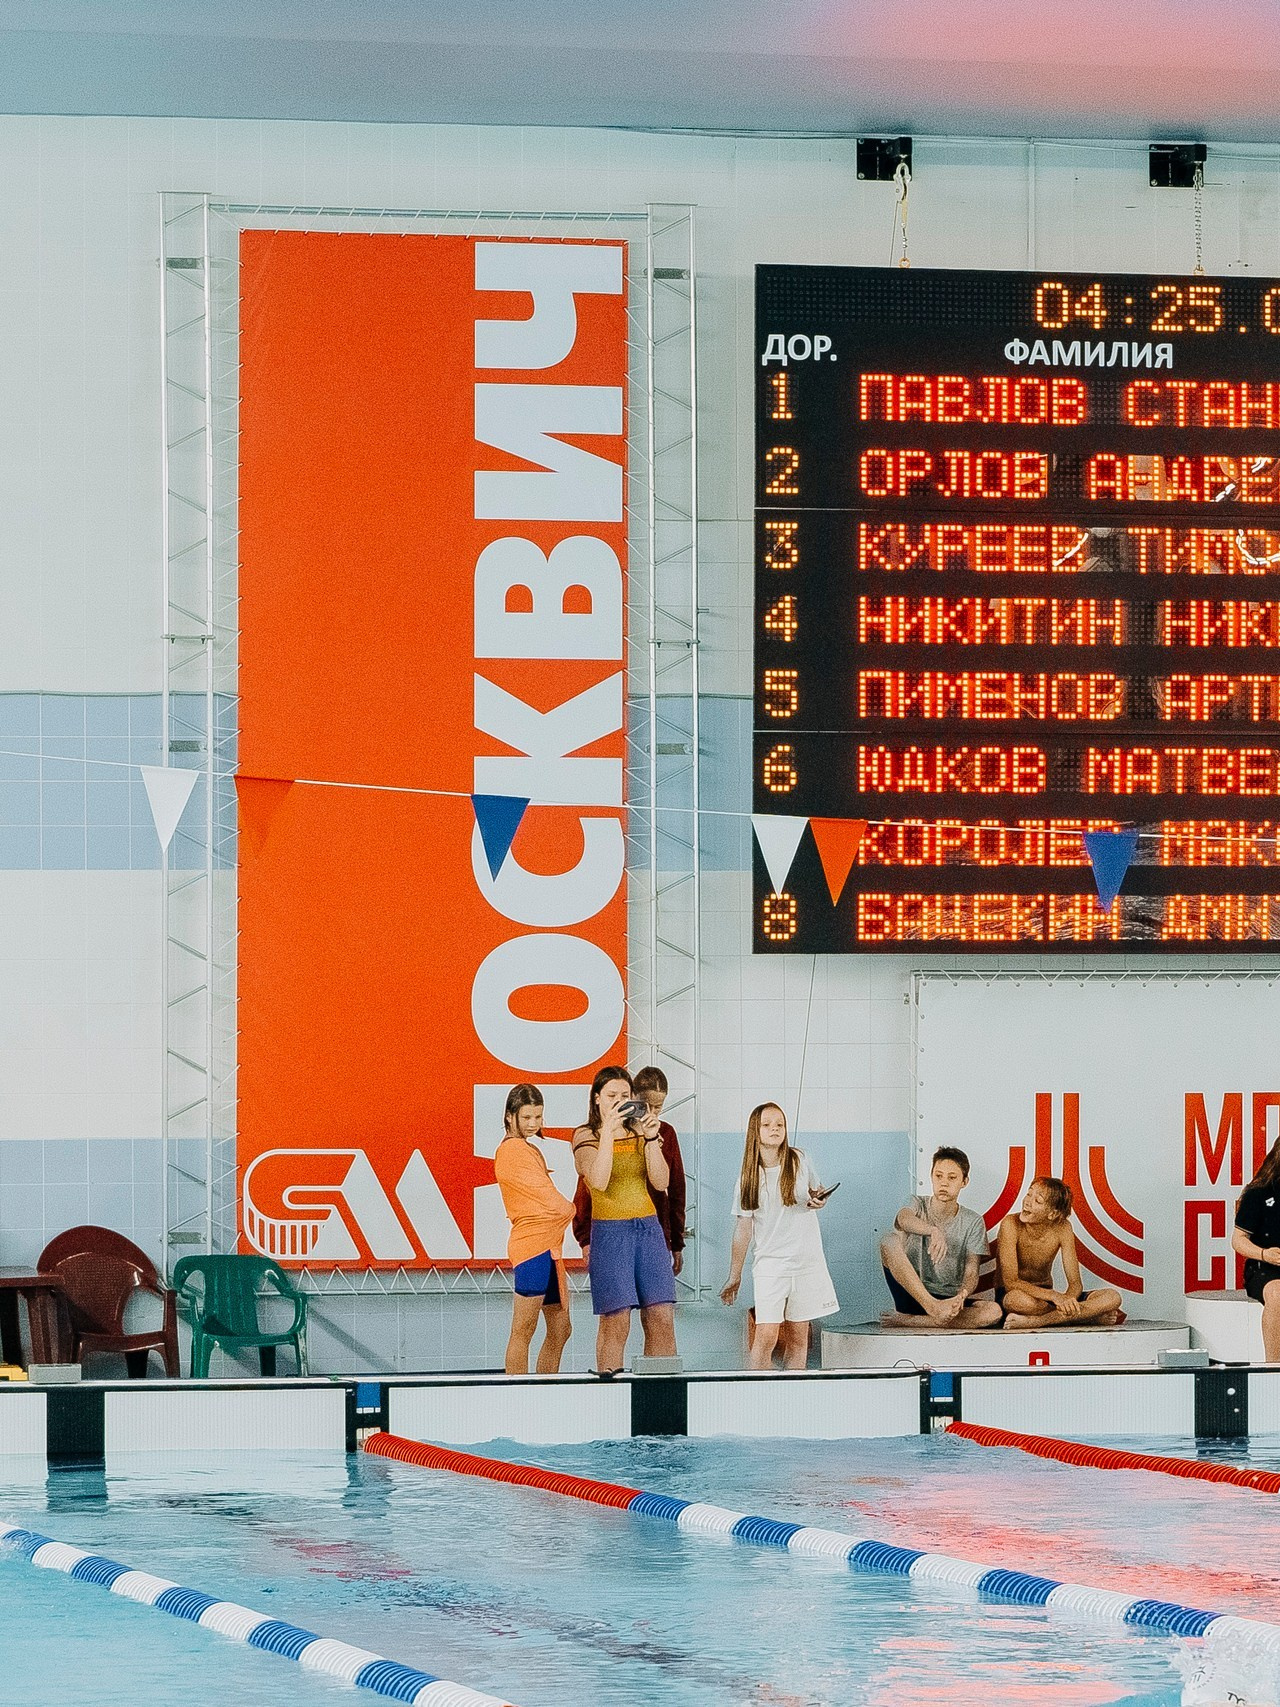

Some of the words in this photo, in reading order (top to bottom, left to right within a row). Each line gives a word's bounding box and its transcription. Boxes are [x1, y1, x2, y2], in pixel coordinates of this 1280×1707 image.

[761, 333, 838, 367] ДОР.
[1003, 337, 1174, 369] ФАМИЛИЯ
[772, 373, 792, 419] 1
[862, 374, 1083, 425] ПАВЛОВ
[766, 448, 798, 494] 2
[861, 449, 1047, 498] ОРЛОВ
[765, 523, 798, 568] 3
[860, 523, 1085, 572] КУРЕЕВ
[765, 596, 797, 642] 4
[860, 596, 1121, 645] НИКИТИН
[765, 670, 798, 717] 5
[860, 671, 1121, 720] ПИМЕНОВ
[764, 745, 796, 792] 6
[859, 746, 1045, 793] ЮДКОВ
[763, 892, 796, 940] 8
